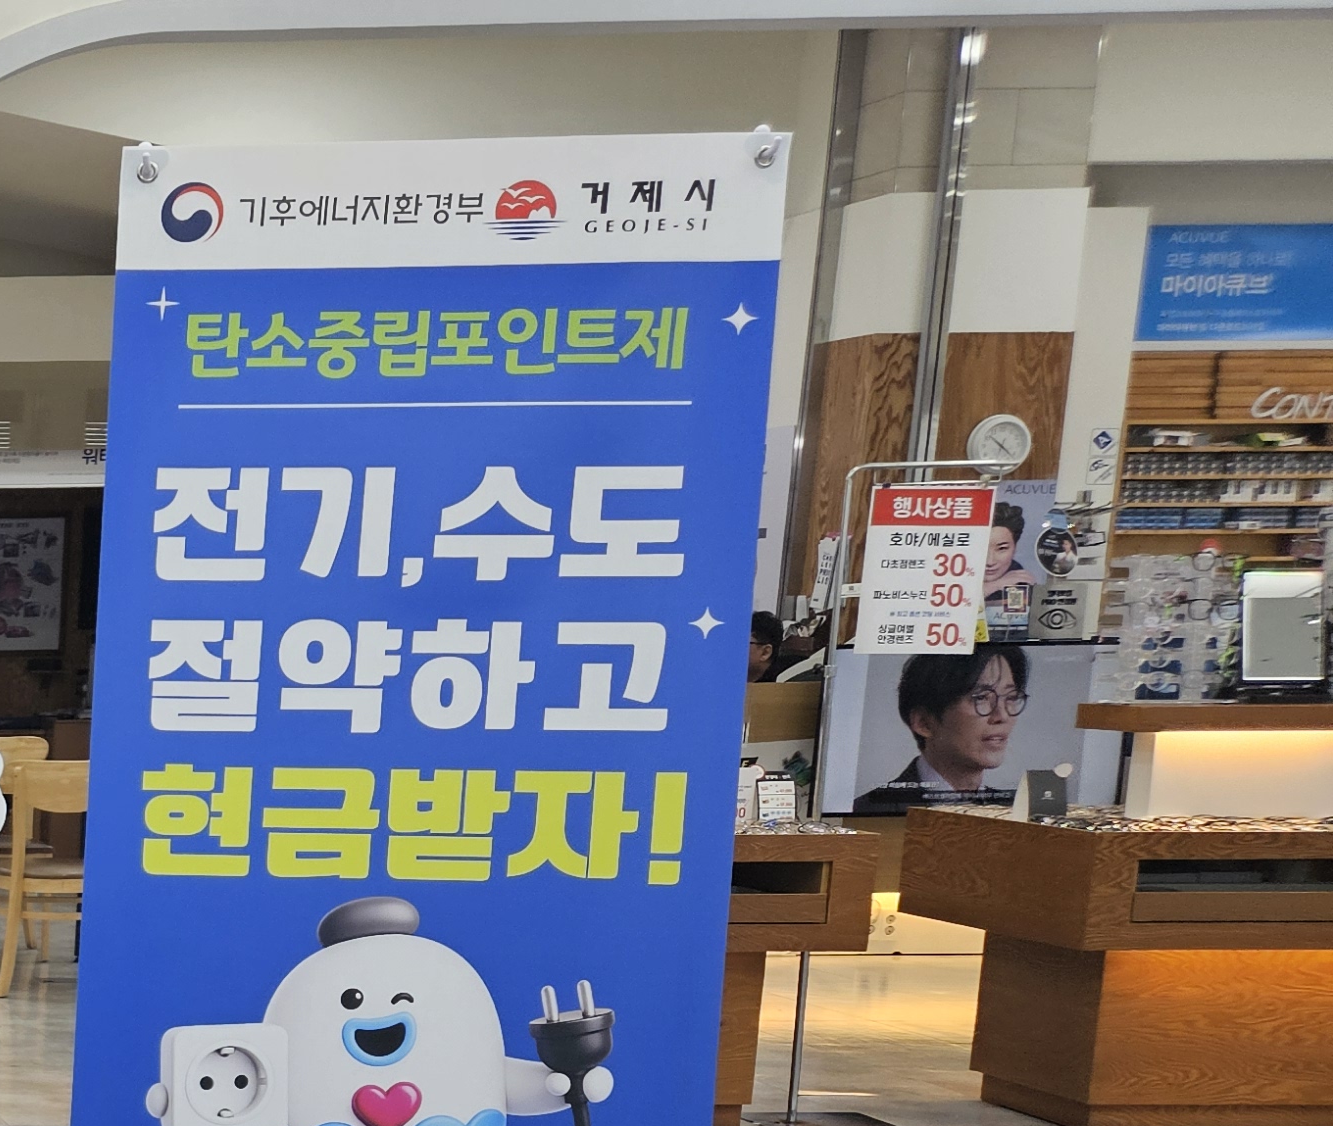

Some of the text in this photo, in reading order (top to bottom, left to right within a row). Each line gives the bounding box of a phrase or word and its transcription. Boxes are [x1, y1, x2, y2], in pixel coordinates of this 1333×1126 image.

[581, 178, 717, 213] 거제시
[239, 193, 484, 226] 기후에너지환경부
[584, 217, 710, 235] GEOJE-SI
[1160, 273, 1275, 297] 마이아큐브
[185, 306, 689, 380] 탄소중립포인트제
[892, 496, 973, 519] 행사상품
[889, 532, 970, 547] 호야/에실로
[932, 553, 975, 577] 30%
[929, 583, 972, 607] 50%
[925, 622, 967, 647] 50%
[147, 619, 670, 733] 절약하고
[140, 762, 688, 885] 현금받자!
